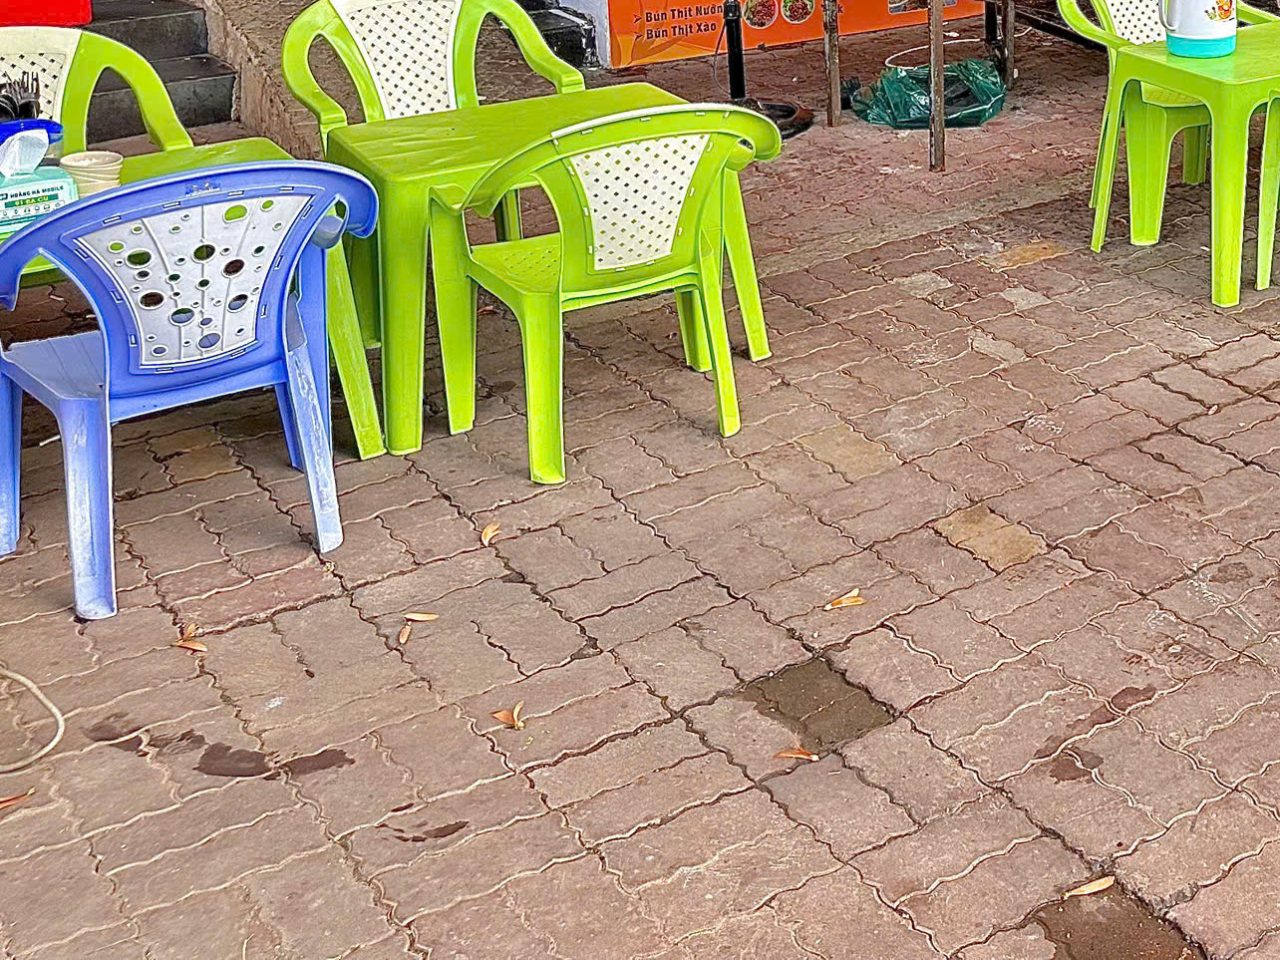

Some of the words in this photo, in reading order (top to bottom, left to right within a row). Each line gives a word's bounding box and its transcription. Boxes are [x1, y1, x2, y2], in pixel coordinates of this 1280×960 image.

[645, 11, 668, 23] Bún
[670, 7, 694, 21] Thịt
[695, 3, 724, 16] Nướn
[646, 26, 669, 40] Bún
[671, 24, 694, 38] Thịt
[696, 22, 717, 34] Xào
